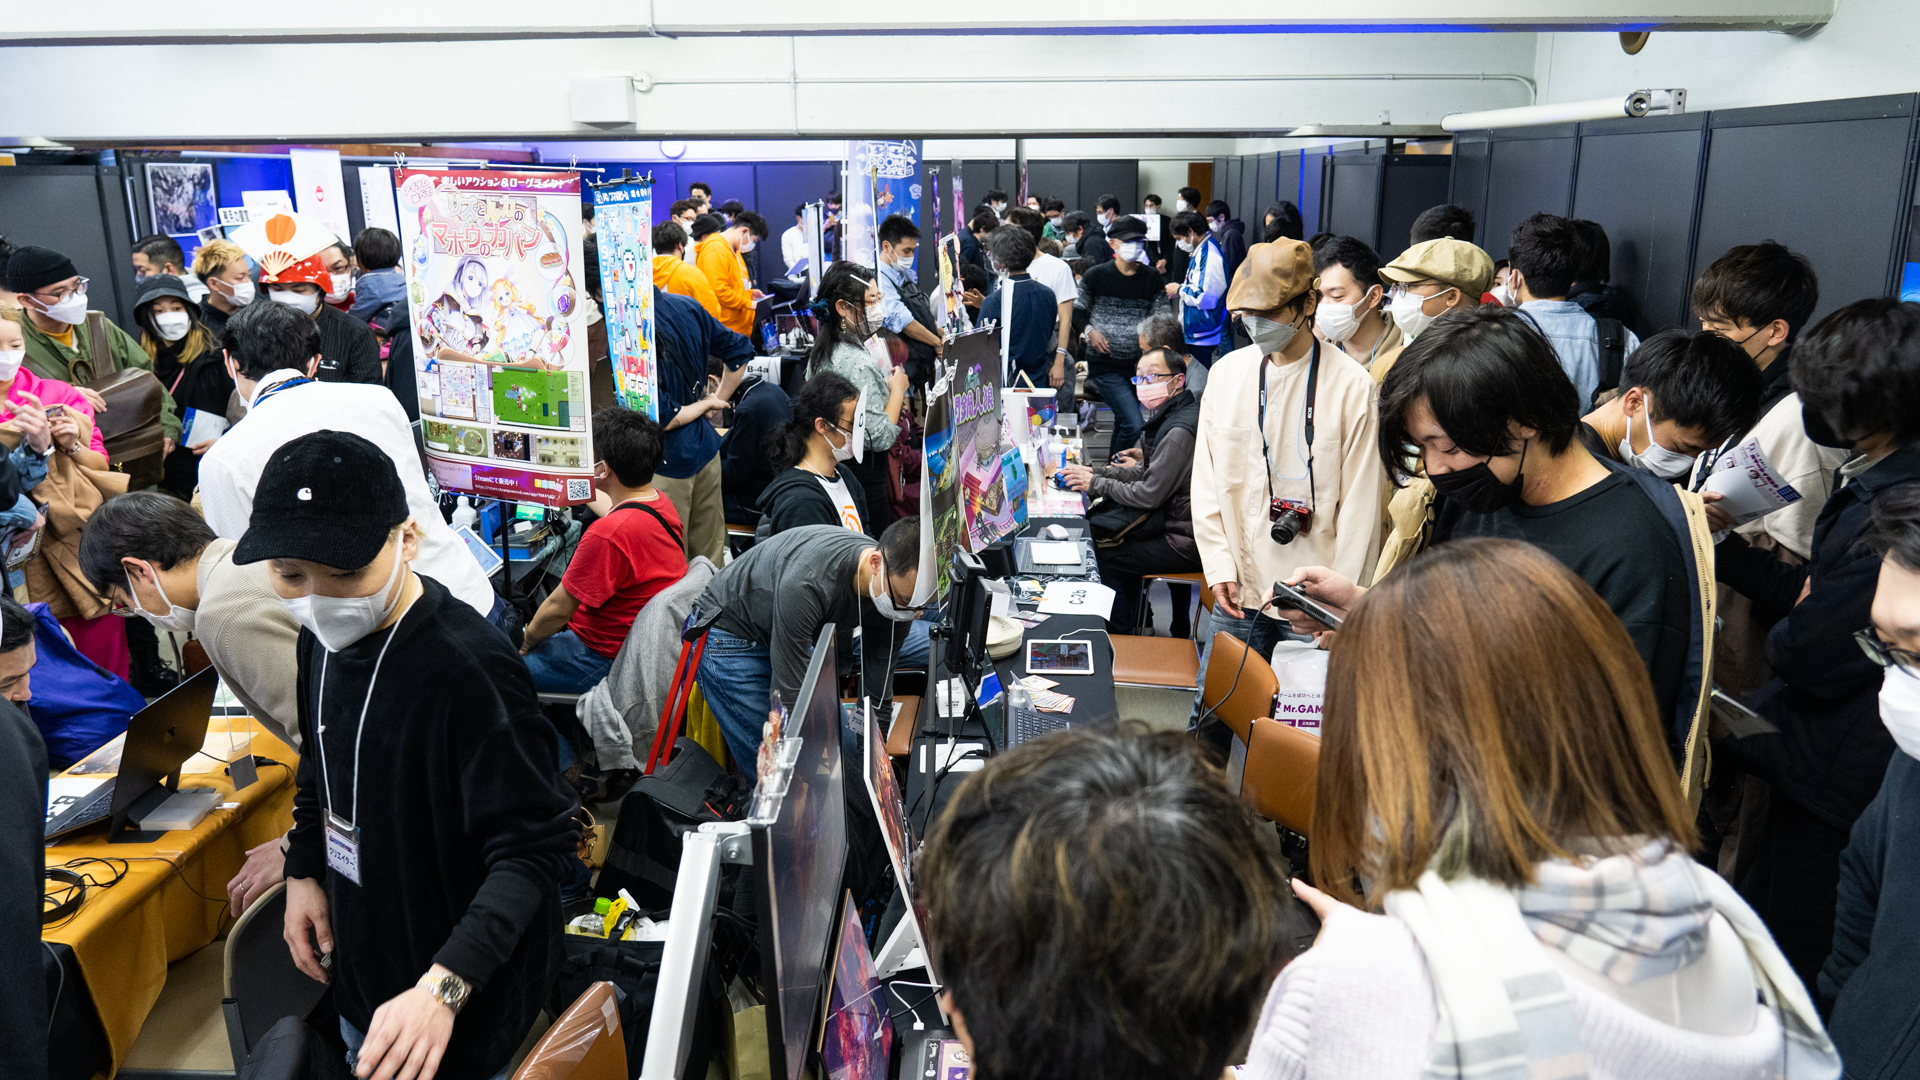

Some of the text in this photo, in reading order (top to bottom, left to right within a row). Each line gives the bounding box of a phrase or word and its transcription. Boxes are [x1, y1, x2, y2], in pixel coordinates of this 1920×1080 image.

[431, 221, 543, 261] マホウのカバン
[747, 366, 769, 374] B-4a
[1069, 589, 1086, 605] C-2b
